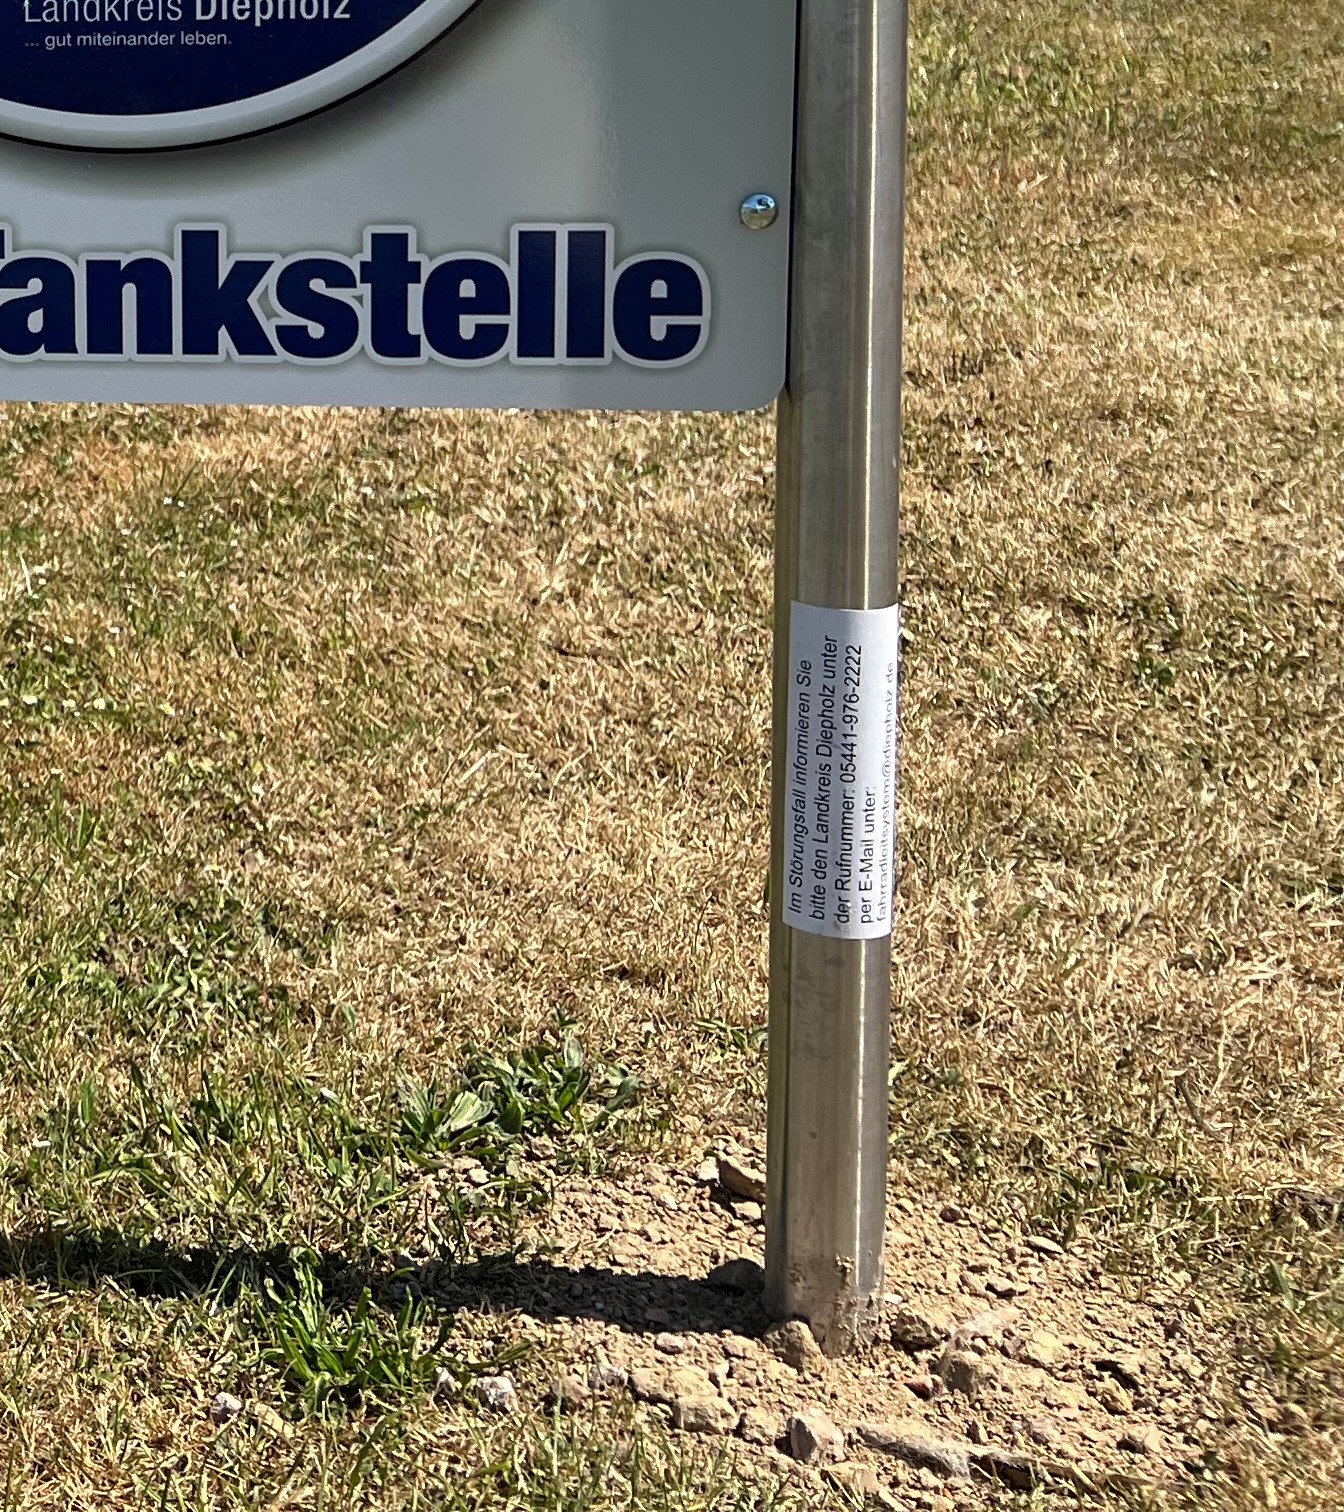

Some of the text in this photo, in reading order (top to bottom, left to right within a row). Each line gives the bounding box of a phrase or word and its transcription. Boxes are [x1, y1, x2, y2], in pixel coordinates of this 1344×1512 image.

[45, 32, 72, 50] gut
[76, 31, 176, 47] miteinander
[180, 30, 233, 46] leben.
[788, 660, 812, 914] Im Störungsfall informieren Sie
[808, 635, 838, 920] bitte den Landkreis Diepholz unter
[833, 645, 862, 924] der Rufnummer: 05441-976-2222
[858, 787, 876, 924] per E-Mail unter:
